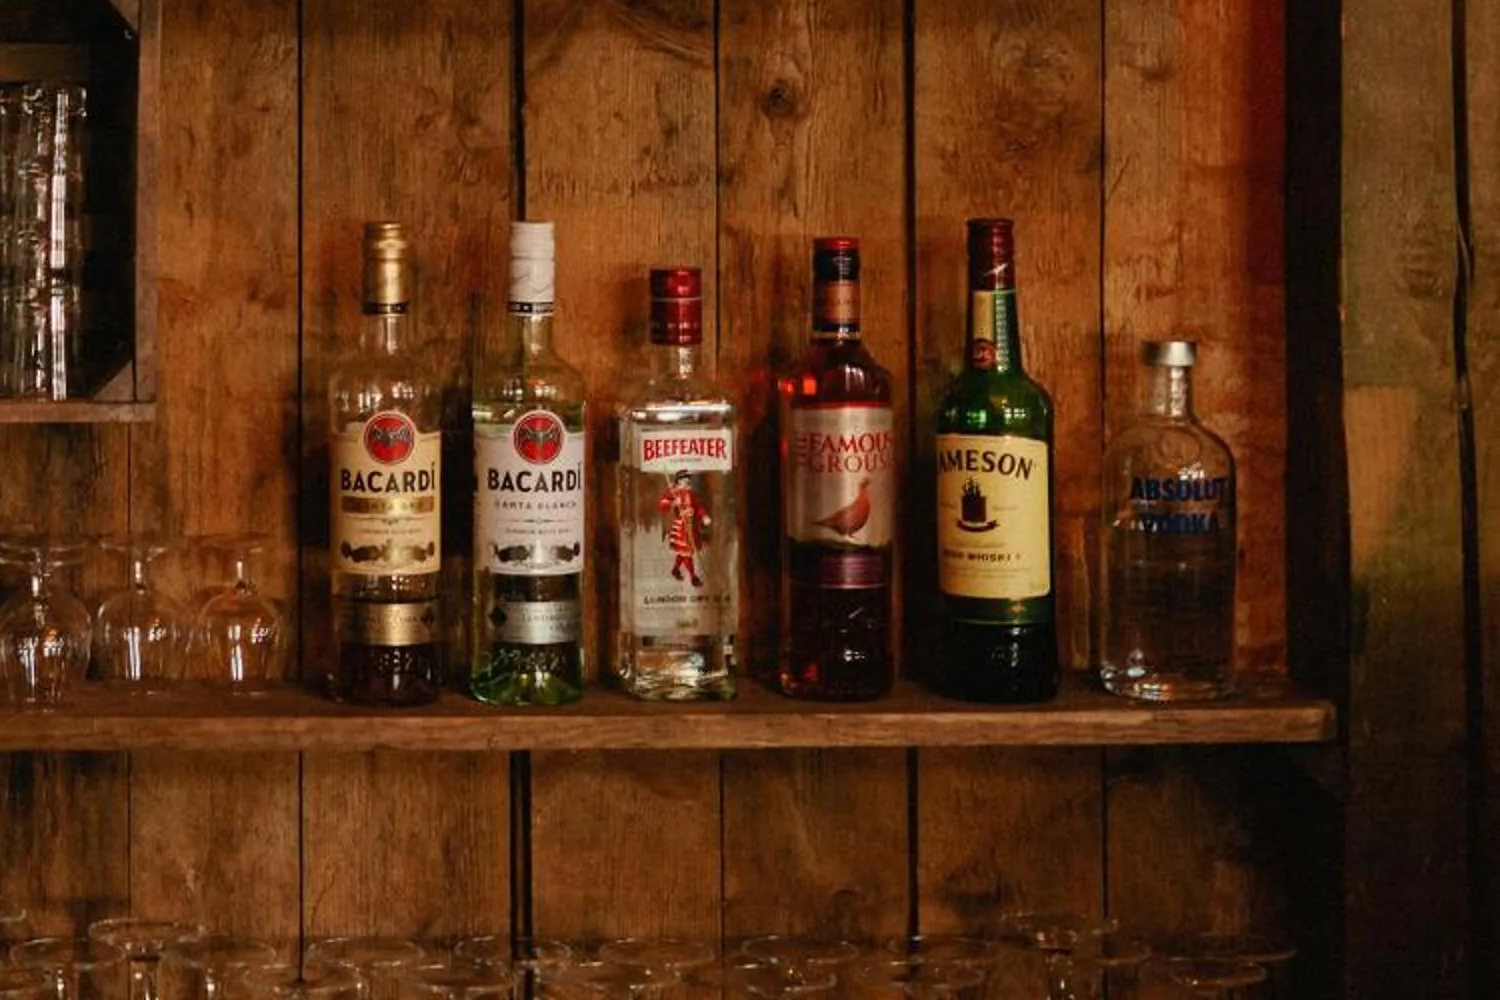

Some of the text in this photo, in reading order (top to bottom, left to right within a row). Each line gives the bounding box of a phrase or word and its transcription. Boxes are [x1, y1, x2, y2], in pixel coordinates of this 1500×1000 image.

[644, 437, 727, 461] BEEFEATER
[808, 453, 889, 473] GROUS
[937, 449, 1033, 480] AMESON
[1130, 477, 1226, 501] ABSOLUT
